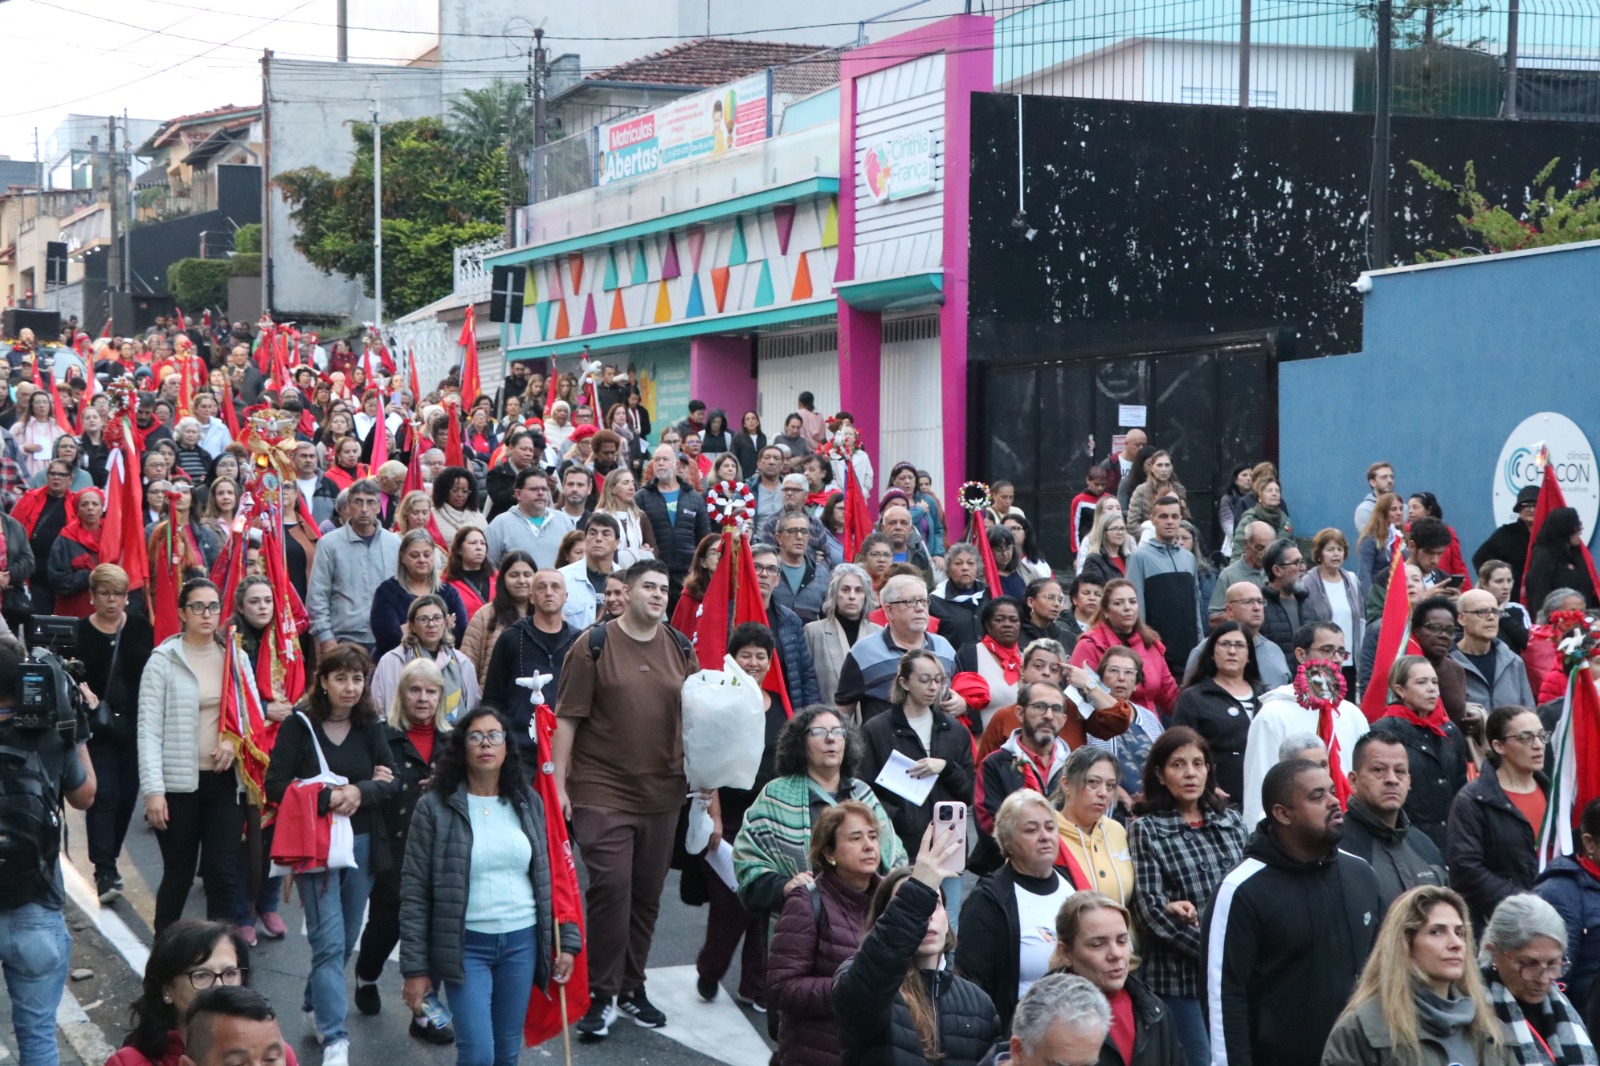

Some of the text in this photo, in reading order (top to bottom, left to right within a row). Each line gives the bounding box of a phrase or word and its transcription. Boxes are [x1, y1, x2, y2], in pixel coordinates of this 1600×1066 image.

[892, 135, 928, 160] Cinthia
[607, 146, 657, 180] Abertas
[1525, 463, 1590, 483] CHCON
